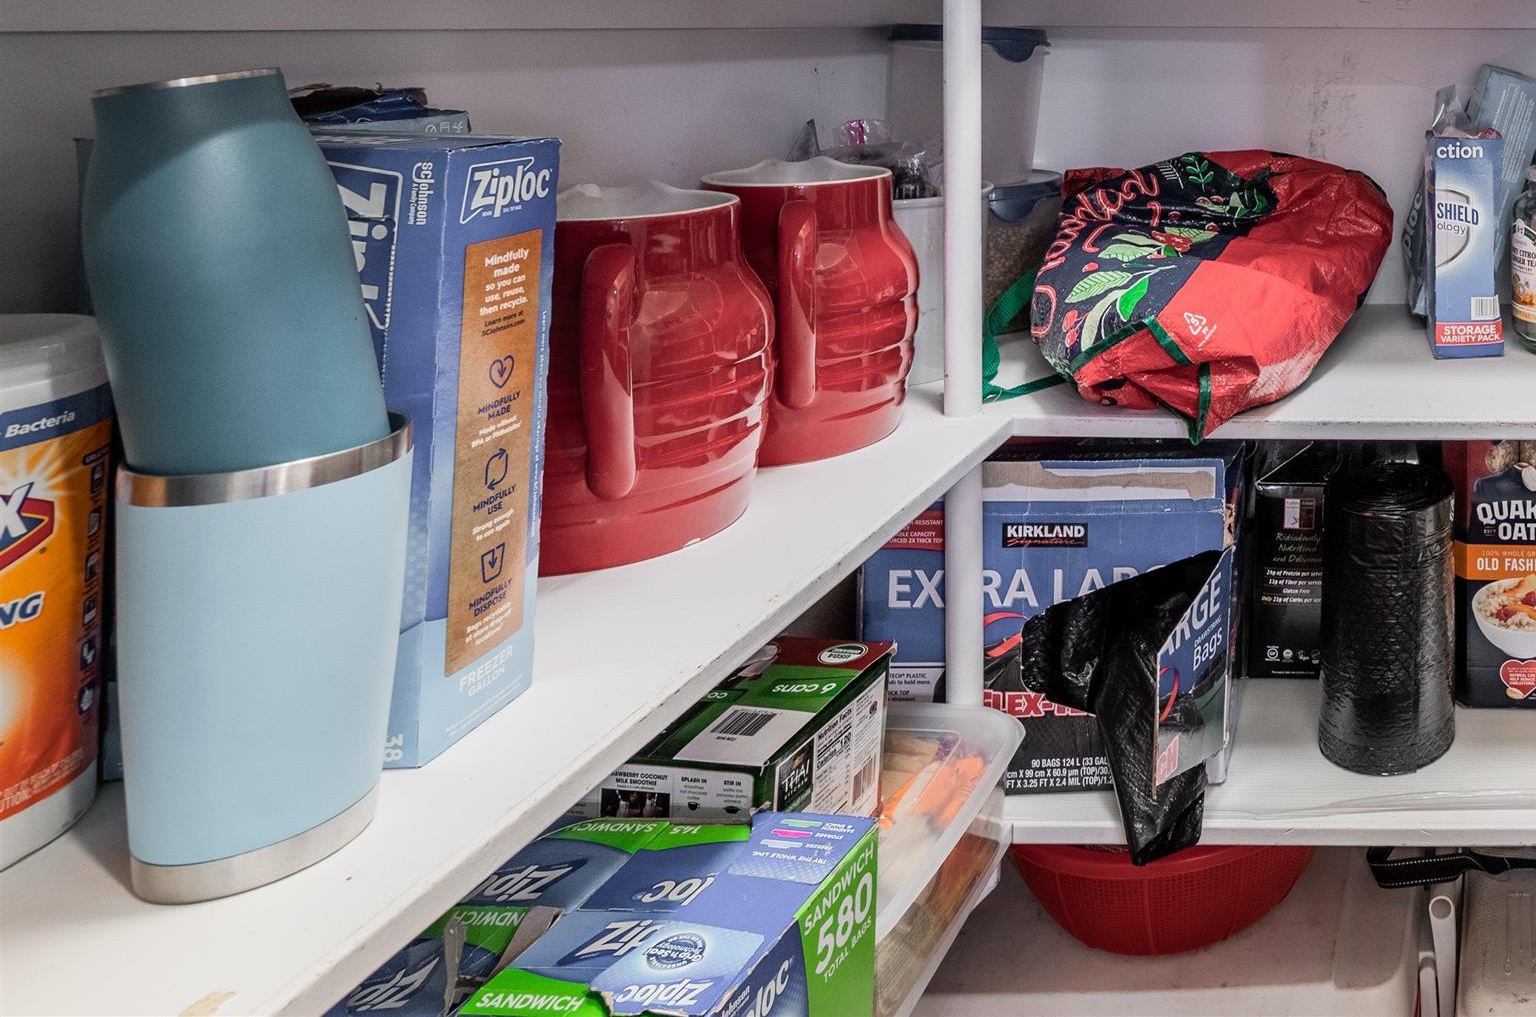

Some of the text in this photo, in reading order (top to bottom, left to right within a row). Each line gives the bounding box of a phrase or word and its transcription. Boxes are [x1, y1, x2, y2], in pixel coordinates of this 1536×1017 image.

[471, 166, 549, 217] Ziploc
[1437, 202, 1479, 226] SHIELD
[1437, 223, 1466, 235] ology
[484, 248, 530, 267] Mindfully
[494, 264, 520, 278] made
[485, 275, 526, 292] so you can
[479, 306, 498, 316] then
[485, 318, 502, 327] Learn
[1443, 325, 1496, 335] STORAGE
[1440, 333, 1500, 343] VARIETY PACK
[478, 391, 521, 415] MINDFULLY
[488, 405, 511, 421] MADE
[5, 410, 76, 439] Bacteria
[472, 485, 516, 513] MINDFULLY
[487, 501, 503, 515] USE
[1007, 526, 1085, 538] KIRKLAND
[1276, 532, 1321, 544] Ridiculously
[1278, 544, 1317, 552] Nutritious
[1477, 558, 1498, 570] OLD
[469, 578, 512, 611] MINDFULLY
[888, 569, 1038, 608] EXRA
[473, 591, 507, 617] DISPOSE
[1193, 627, 1222, 671] Bags
[459, 645, 513, 692] FREEZER
[468, 665, 505, 697] GALLON
[772, 684, 817, 693] cans
[817, 719, 838, 738] Nutrition
[816, 748, 836, 769] Calories
[1032, 758, 1075, 768] 90 BAGS 124
[641, 773, 668, 781] COCONUT
[781, 759, 810, 793] THAI
[1025, 768, 1066, 777] 99 60.9
[1023, 777, 1080, 787] 3.25 FT 2.4 MIL
[771, 853, 799, 861] WHOLE
[804, 842, 874, 936] SANDWICH
[815, 872, 872, 975] 580
[824, 916, 872, 983] TOTAL BAGS
[477, 993, 586, 1013] SANDWICH
